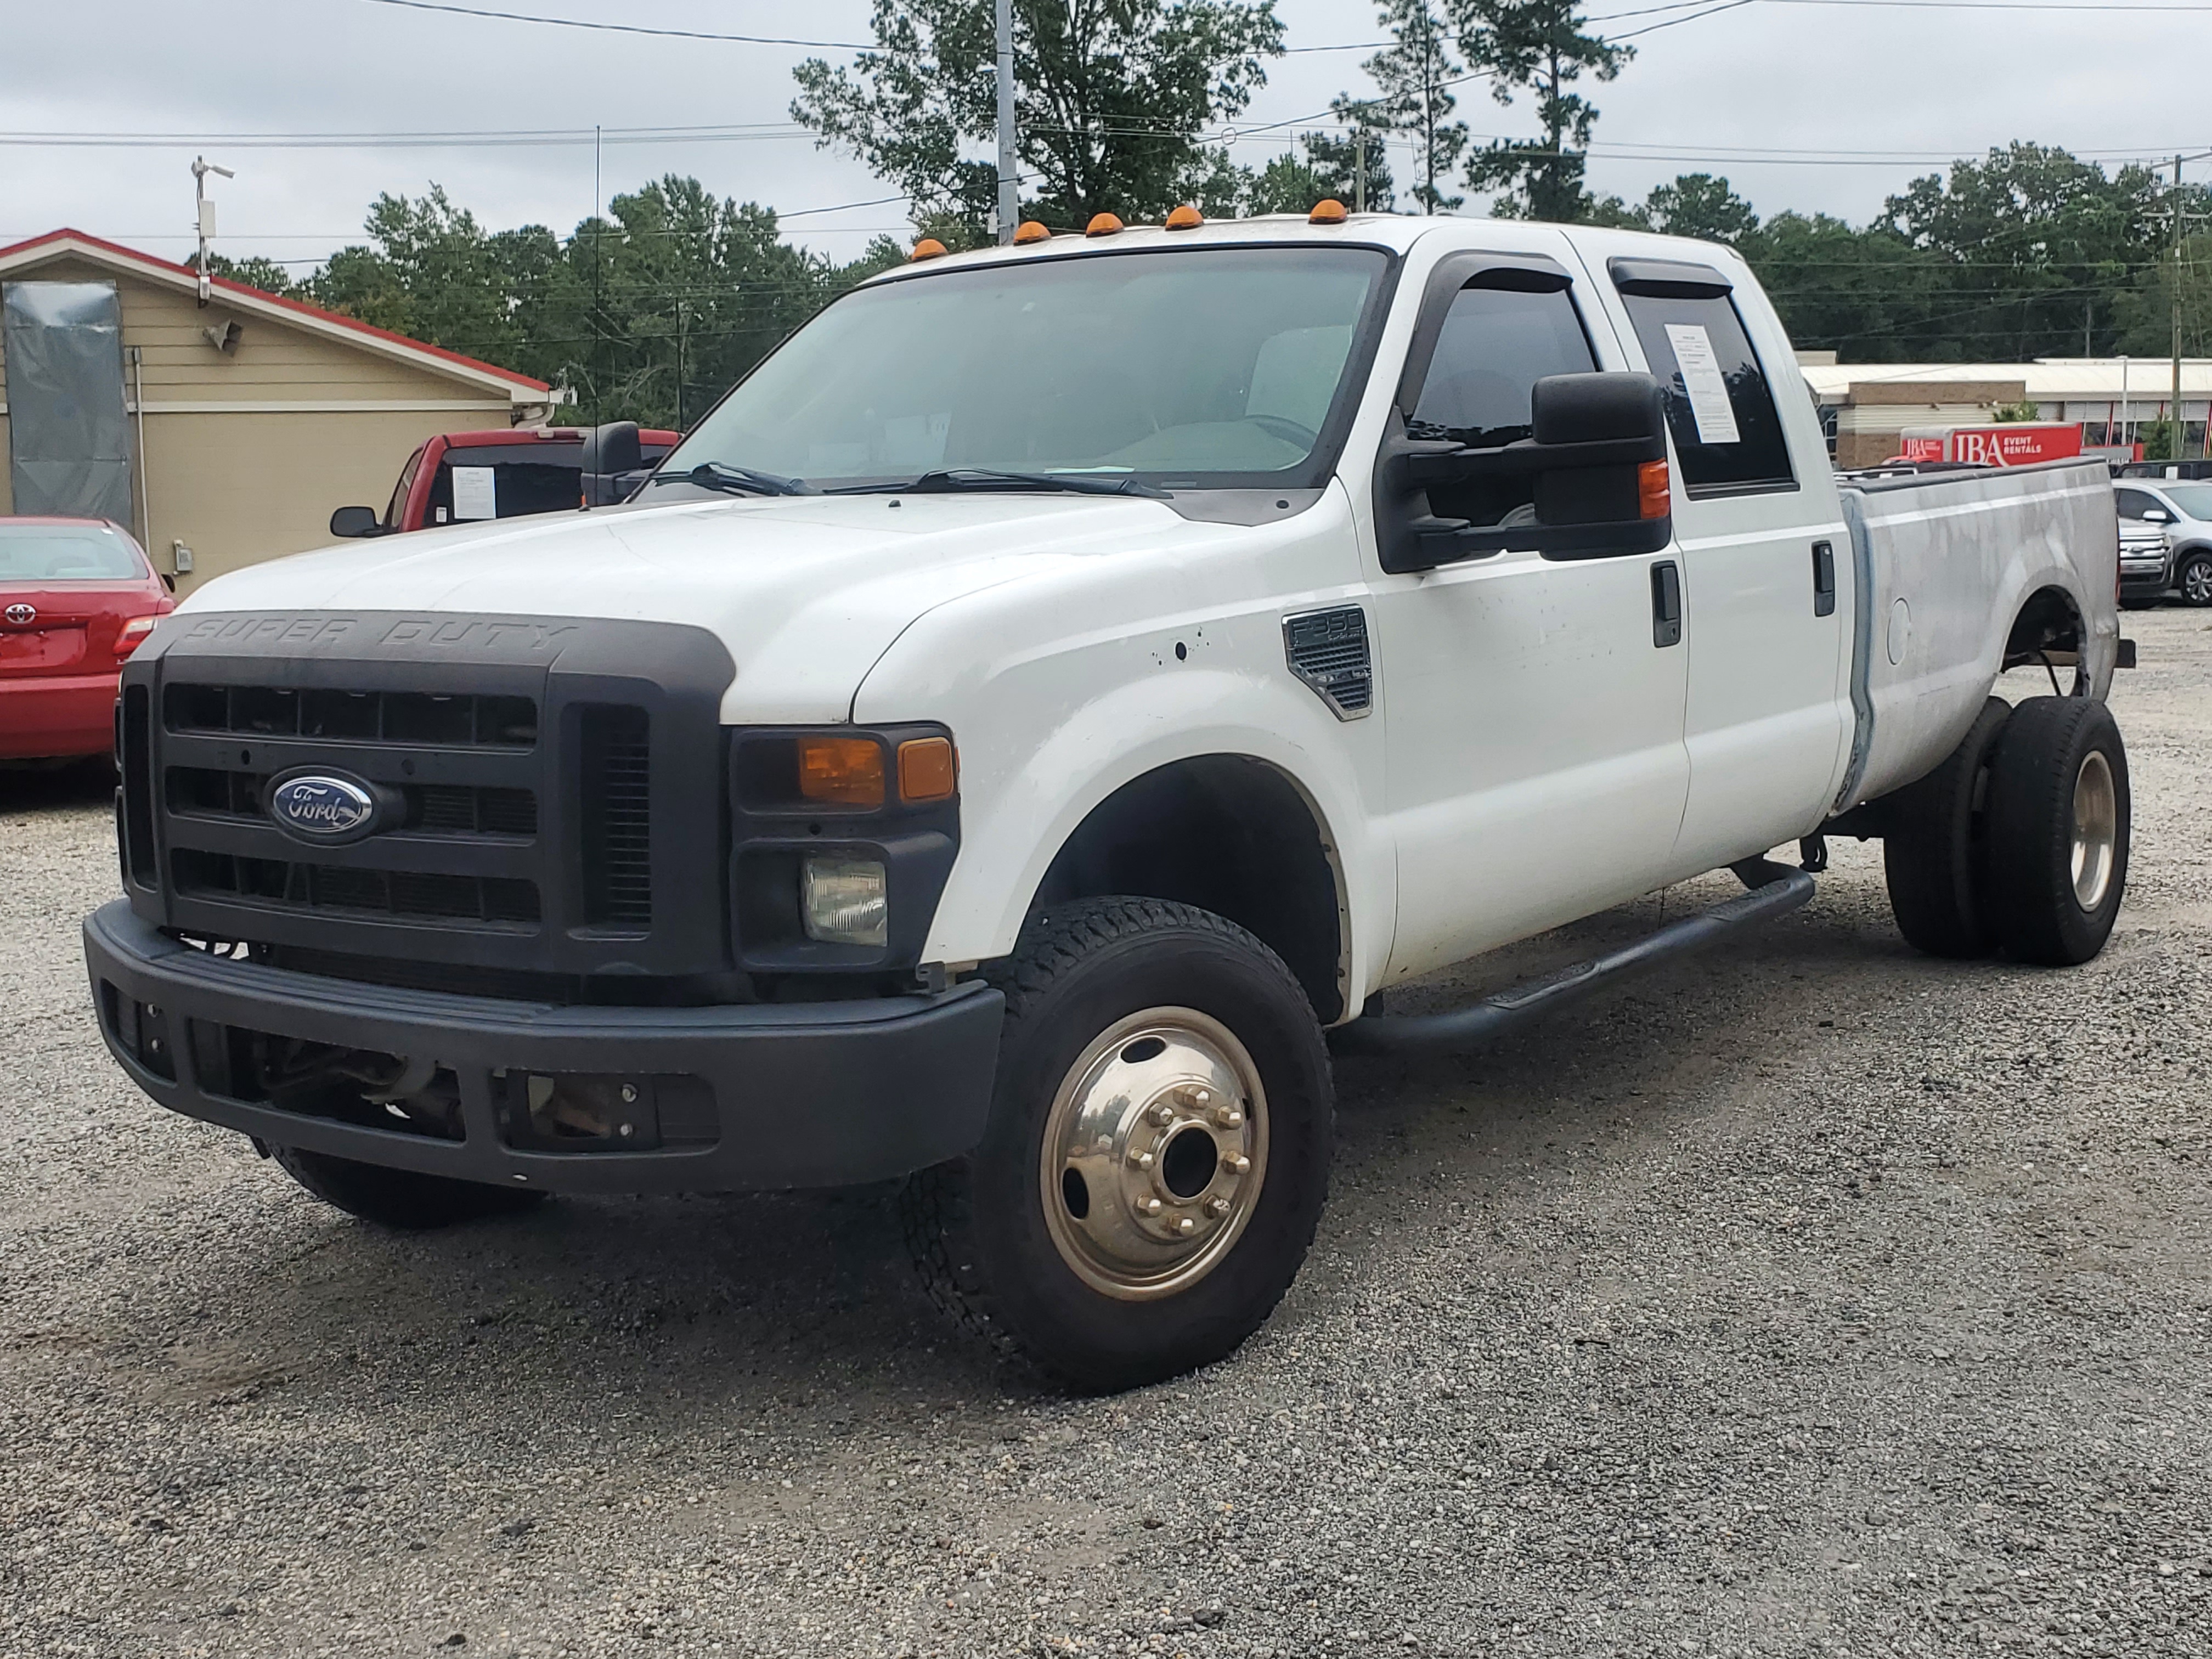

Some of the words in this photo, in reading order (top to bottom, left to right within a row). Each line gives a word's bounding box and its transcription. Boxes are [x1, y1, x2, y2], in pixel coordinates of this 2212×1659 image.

[2004, 436, 2032, 445] EVENT
[2004, 444, 2041, 454] RENTALS
[185, 618, 359, 642] SUPER
[379, 620, 580, 649] DUTY
[289, 785, 352, 826] Ford
